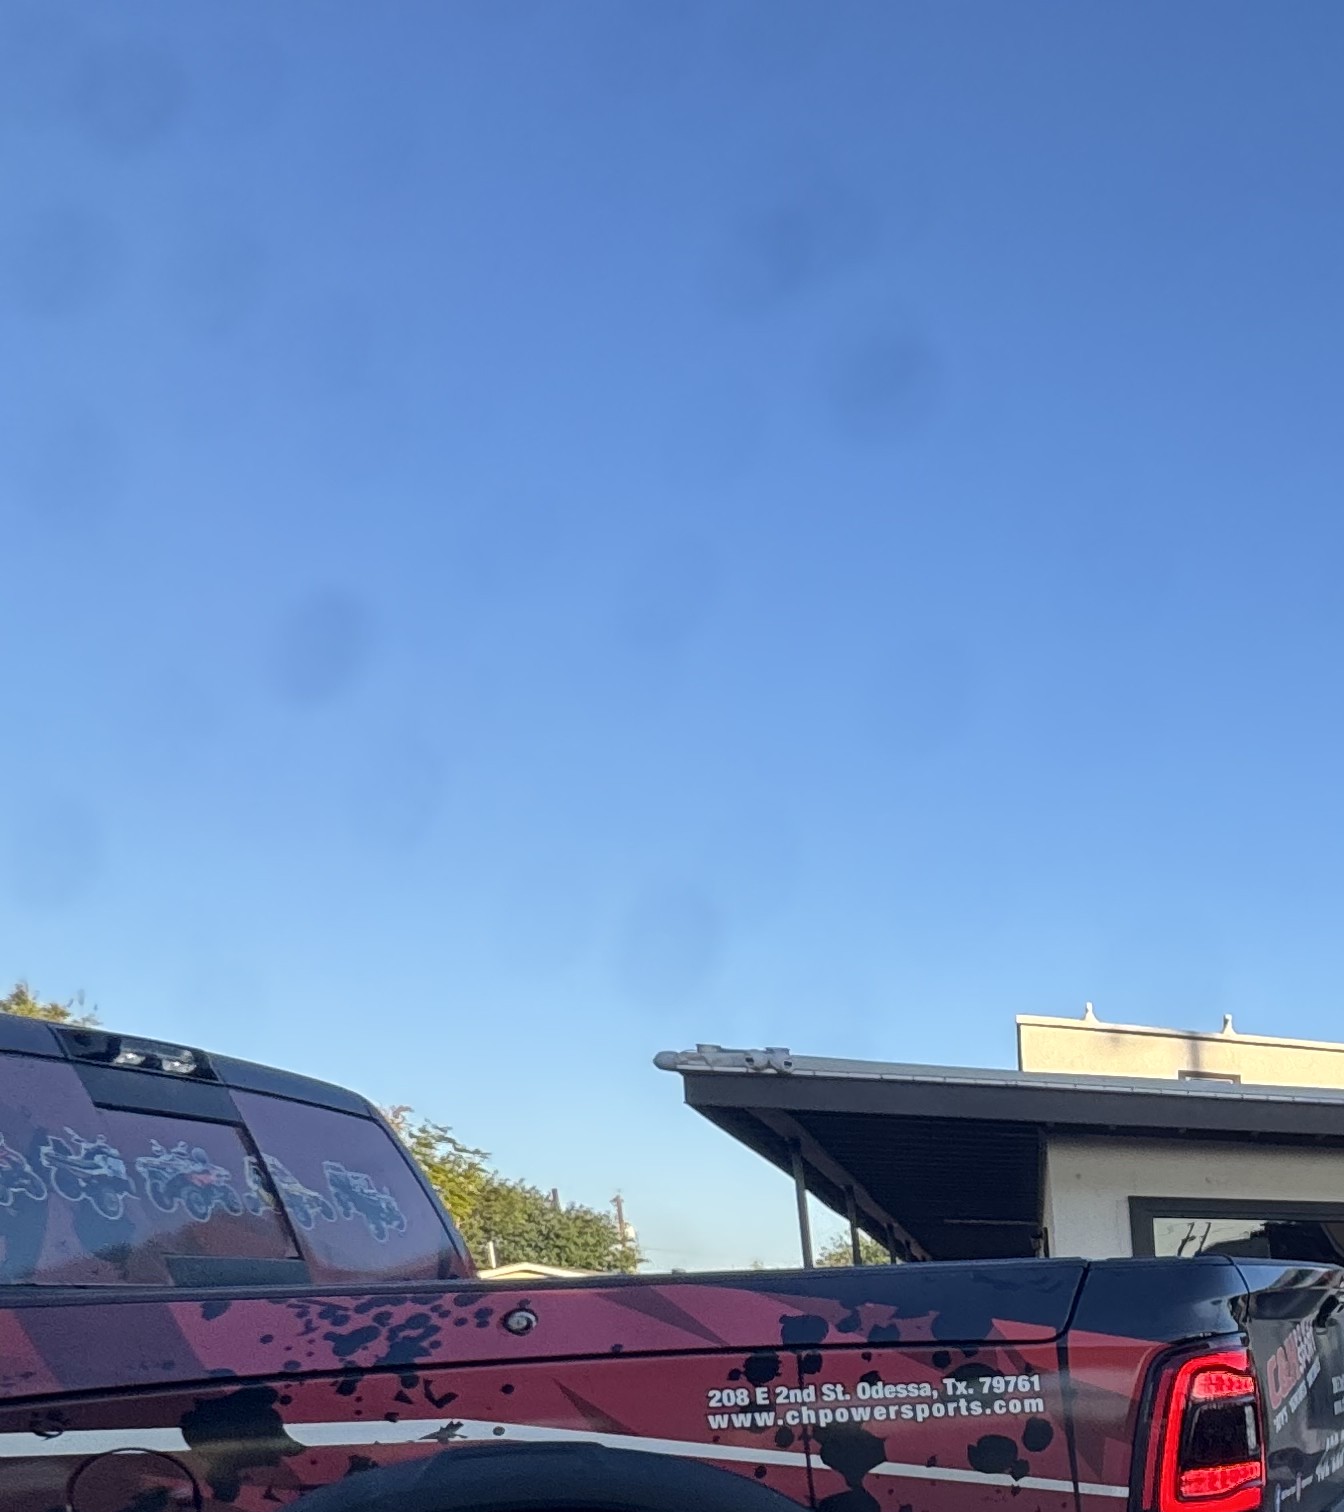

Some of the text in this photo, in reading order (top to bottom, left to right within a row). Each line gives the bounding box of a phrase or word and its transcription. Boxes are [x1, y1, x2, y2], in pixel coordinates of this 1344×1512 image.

[707, 1374, 1042, 1408] 208 E 2nd St. Odessa, Tx. 79761
[707, 1396, 1045, 1429] www.chpowersports.com
